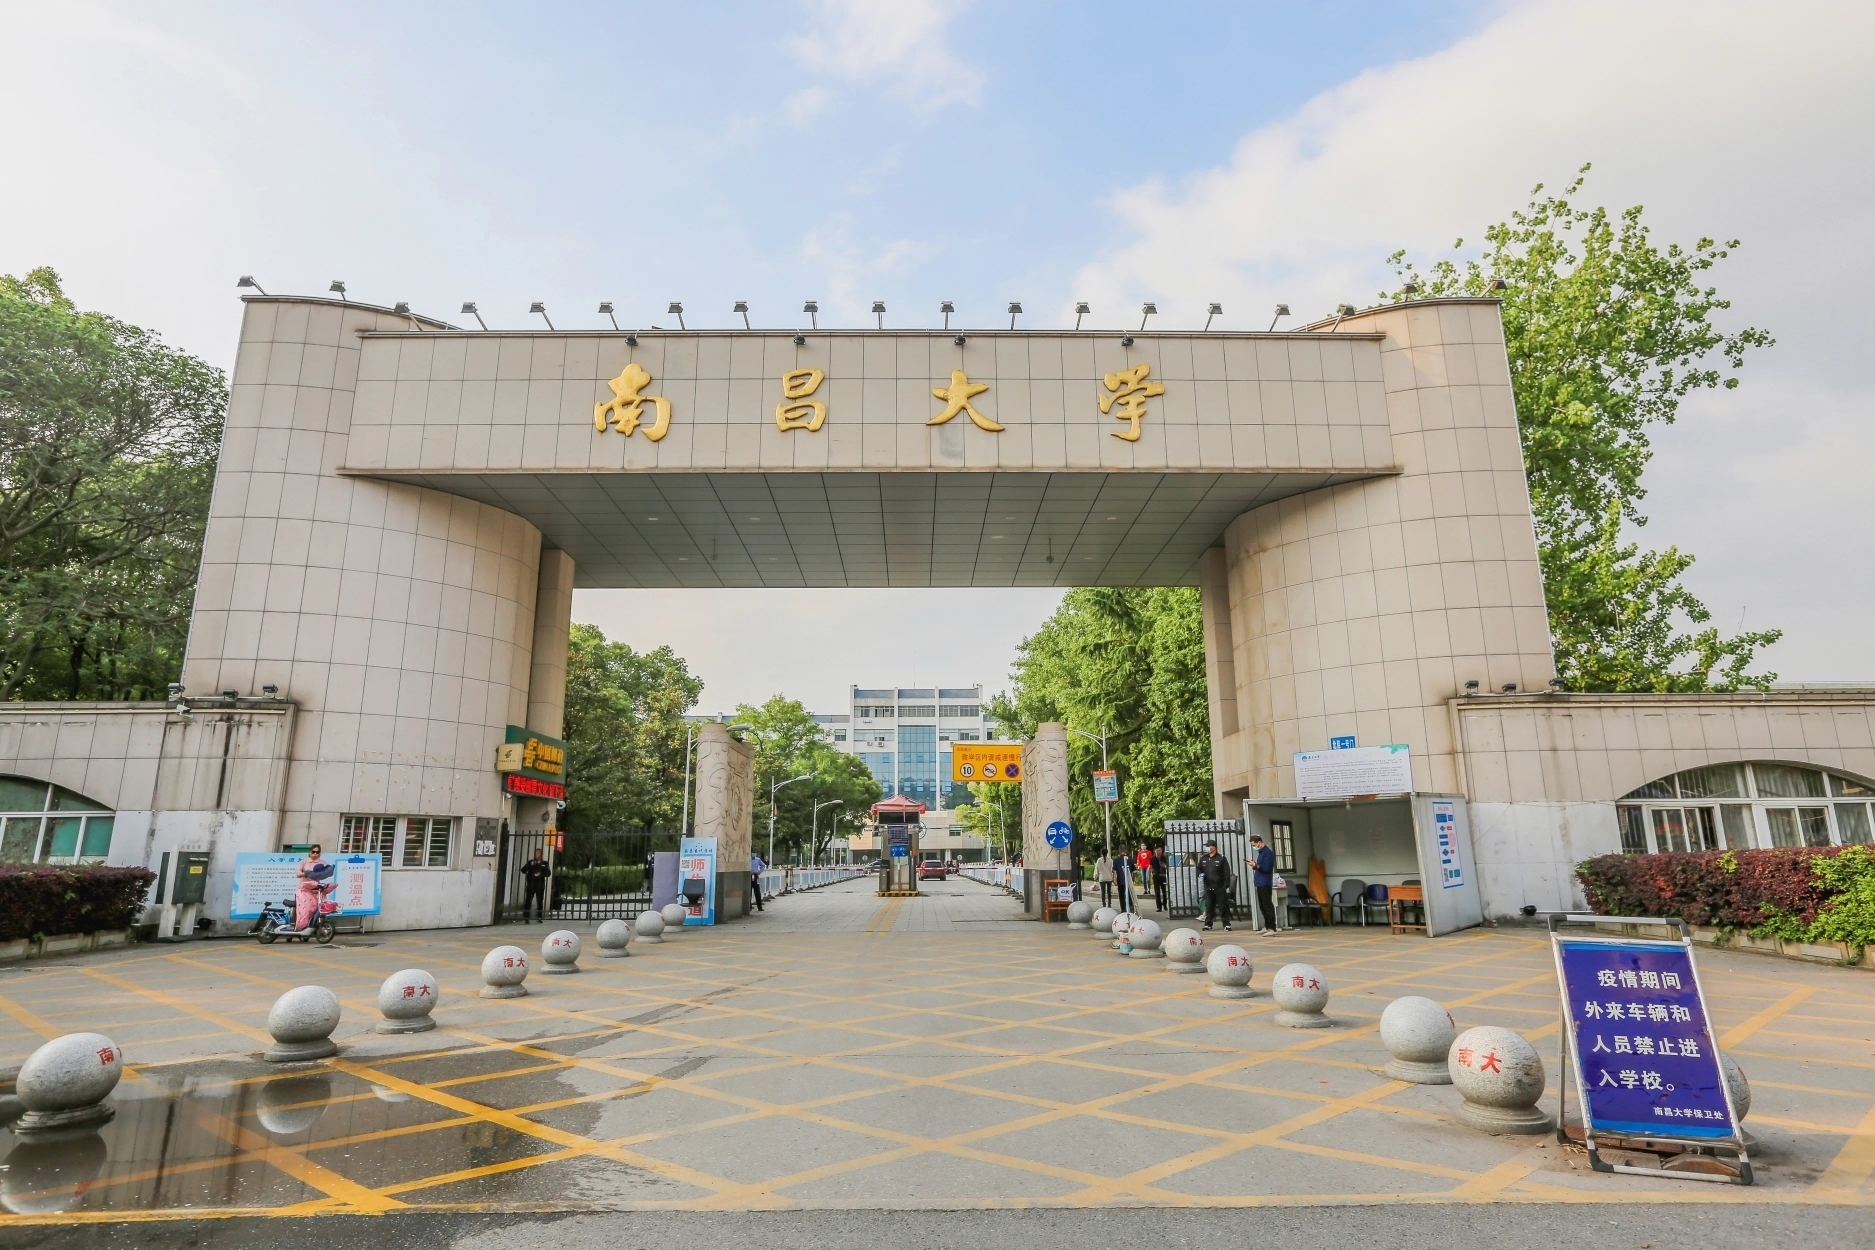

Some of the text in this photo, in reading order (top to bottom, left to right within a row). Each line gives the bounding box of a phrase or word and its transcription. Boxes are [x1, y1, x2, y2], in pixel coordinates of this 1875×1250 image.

[593, 363, 1165, 443] 南昌大学
[963, 766, 972, 775] 10
[349, 872, 365, 906] 测温点
[552, 937, 573, 948] 南大
[503, 956, 526, 968] 南大
[1227, 956, 1250, 967] 南大
[1291, 975, 1321, 991] 南大
[1597, 969, 1681, 990] 疫情期间
[403, 984, 431, 998] 南大
[1584, 1001, 1692, 1023] 外来车辆和
[1592, 1035, 1701, 1058] 人员禁止进
[1458, 1047, 1503, 1074] 南大
[1599, 1069, 1675, 1092] 入学校。
[1653, 1106, 1725, 1120] 南昌大学保卫处
